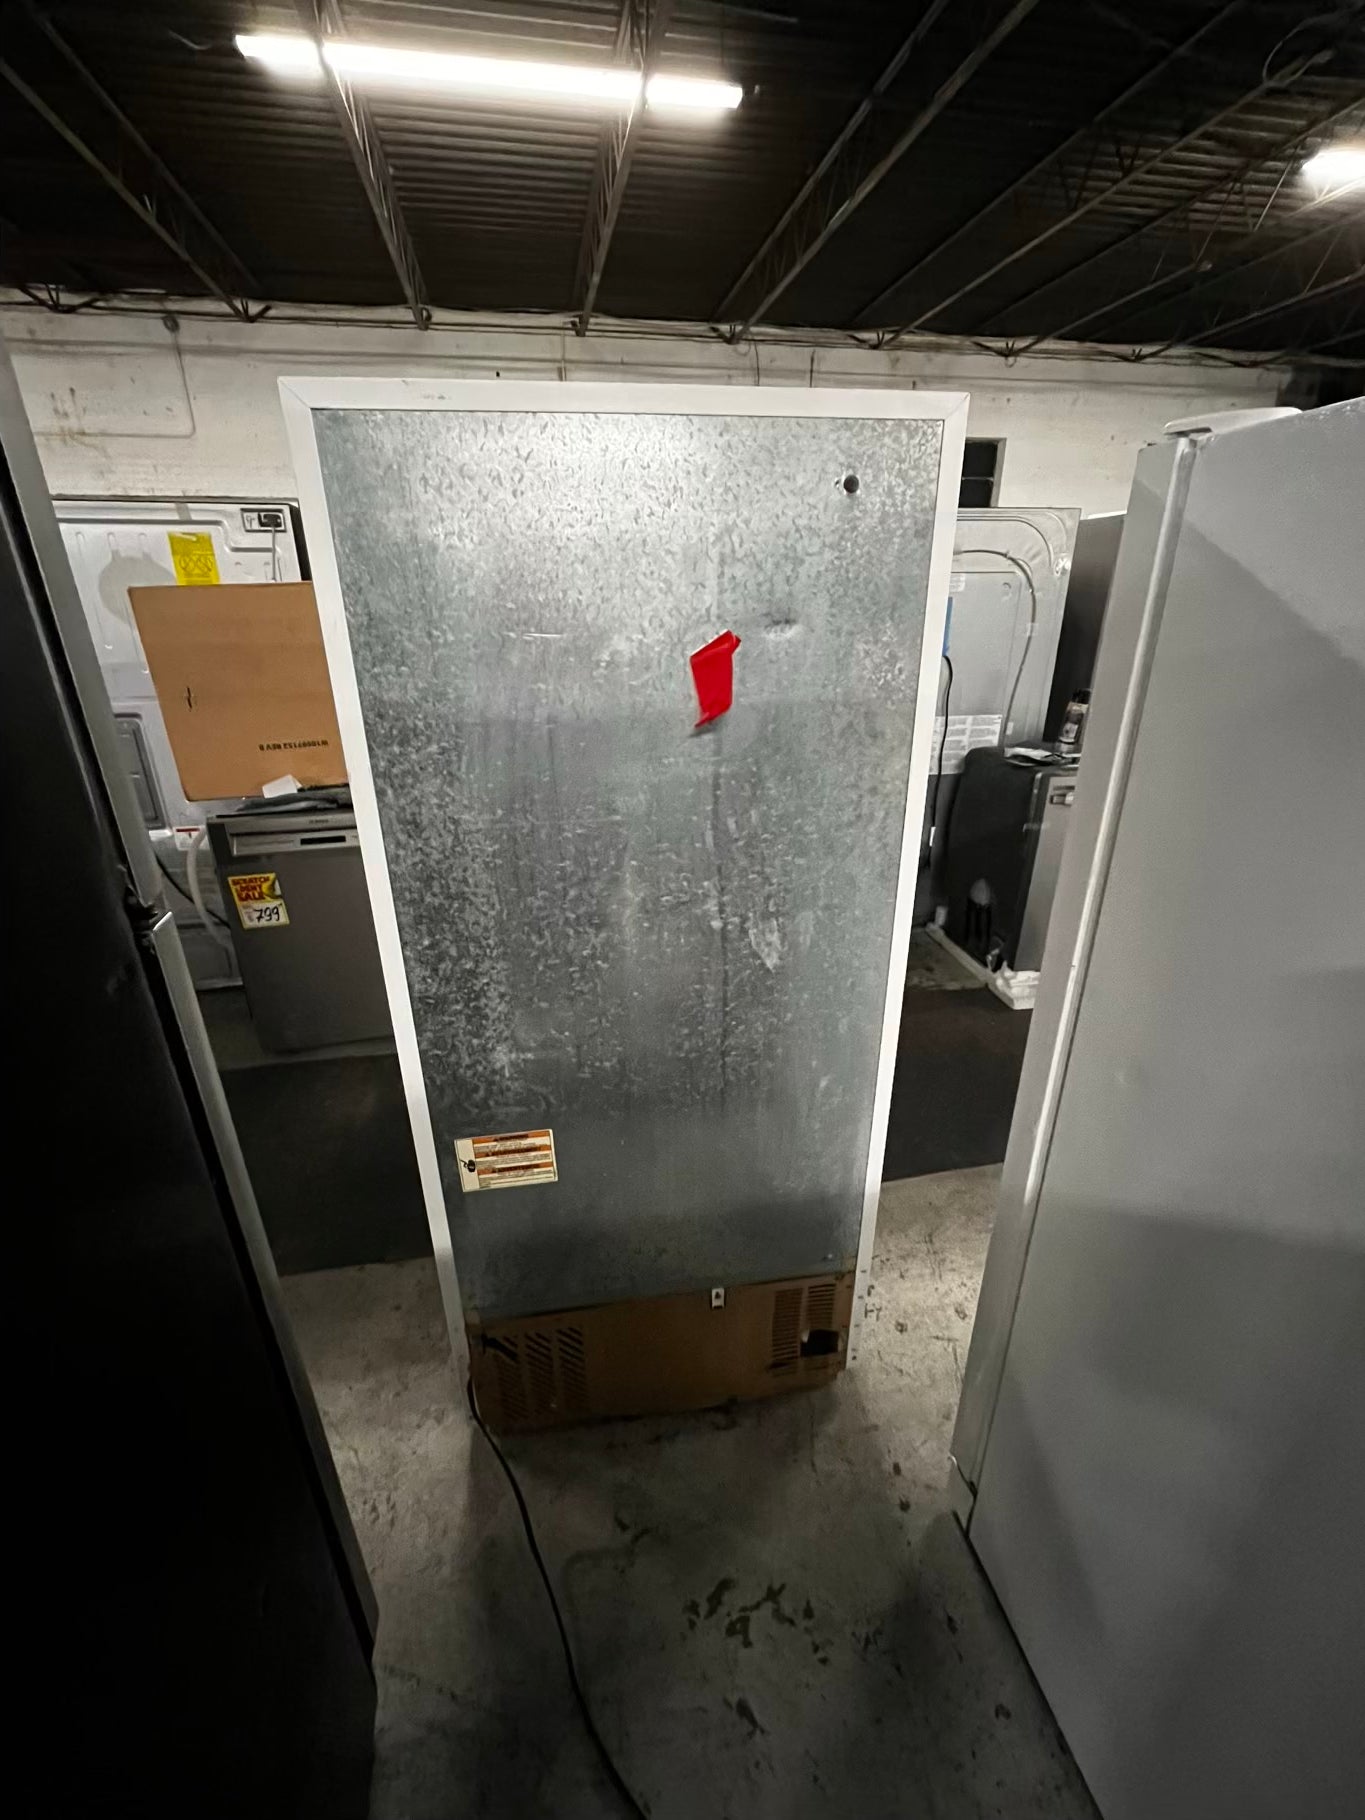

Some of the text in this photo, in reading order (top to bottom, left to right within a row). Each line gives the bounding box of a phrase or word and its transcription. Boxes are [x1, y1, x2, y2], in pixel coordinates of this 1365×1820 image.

[231, 876, 270, 886] SCRATCH
[240, 883, 263, 893] DENT
[237, 890, 266, 902] SALE
[253, 905, 280, 923] 799
